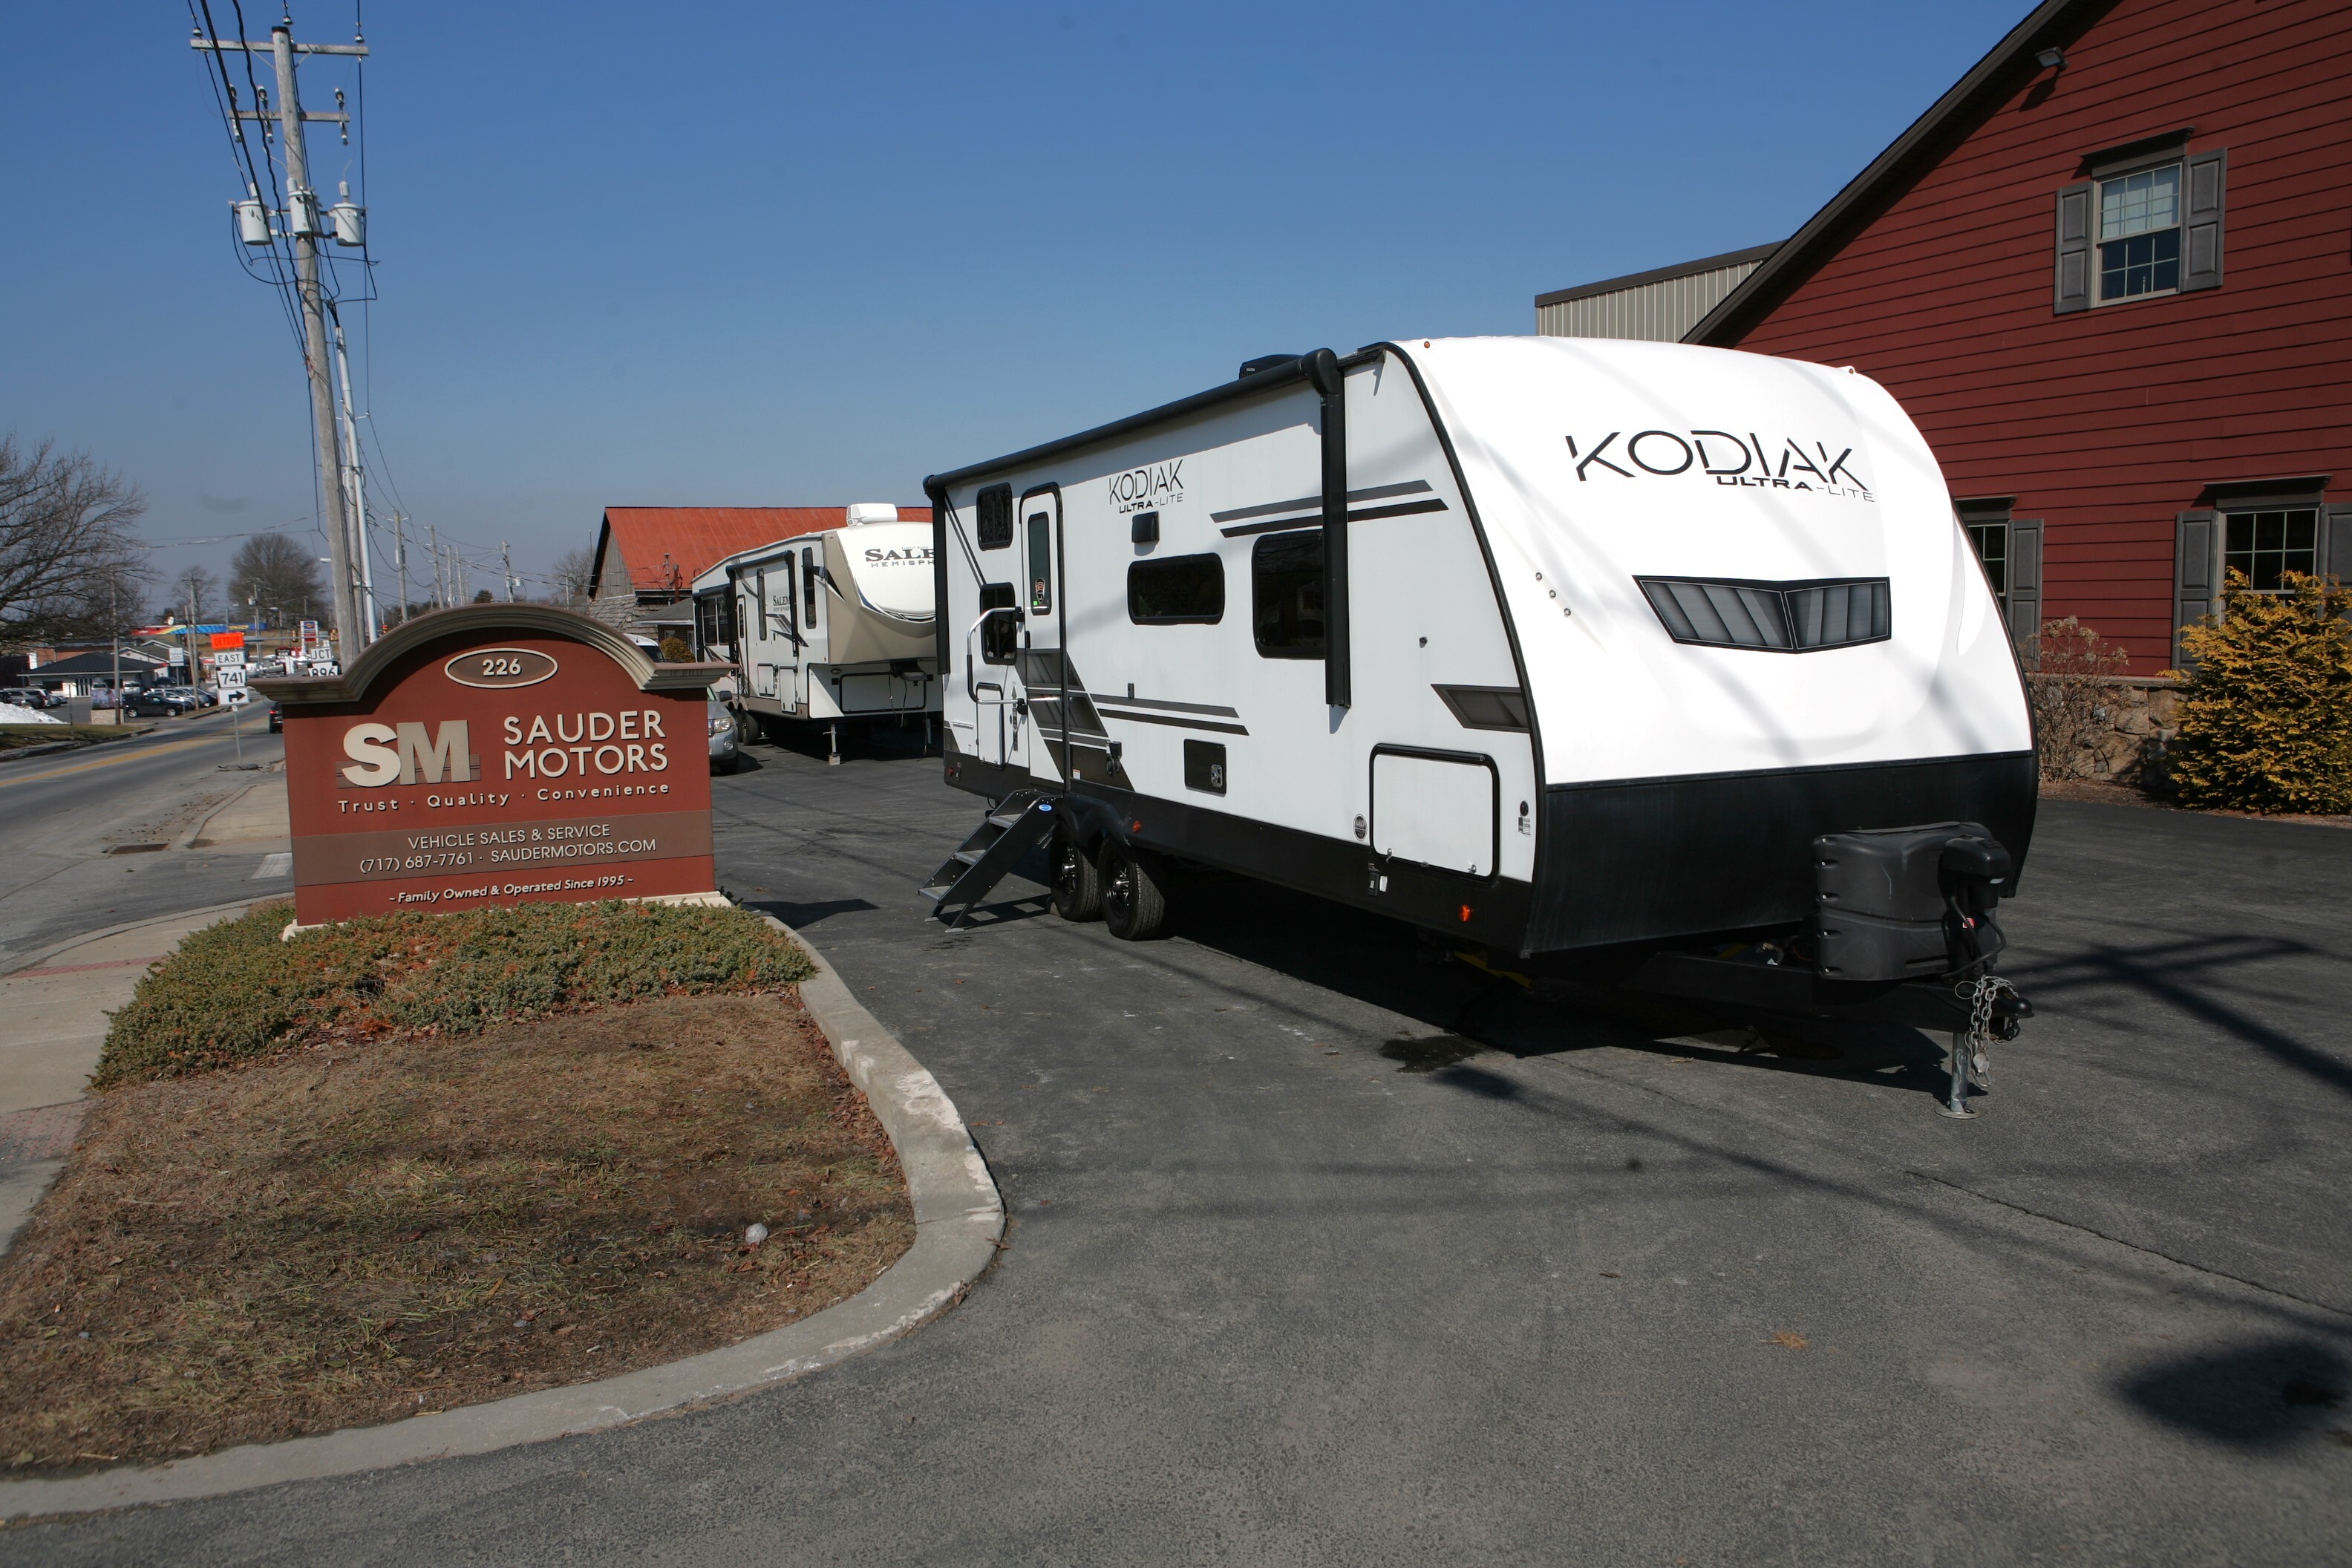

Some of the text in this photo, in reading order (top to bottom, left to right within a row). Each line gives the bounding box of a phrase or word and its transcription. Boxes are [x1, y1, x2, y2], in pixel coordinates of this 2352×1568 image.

[1565, 430, 1870, 491] KODIAK
[1108, 459, 1183, 505] KODIAK
[1716, 476, 1875, 503] ULTRA-LITE
[1119, 492, 1183, 514] ULTRA-LITE
[214, 635, 241, 646] DETOUR
[218, 653, 240, 664] EAST
[313, 649, 330, 660] JCT
[483, 659, 521, 676] 226
[220, 672, 244, 685] 741
[312, 667, 336, 676] 896
[503, 710, 666, 745] SAUDER
[342, 719, 471, 787] SM
[504, 743, 668, 780] MOTORS
[338, 784, 669, 813] Trust Quality Convenience
[408, 823, 610, 849] VEHICLE SALES & SERVICE
[360, 839, 656, 874] (717) 687-7761 SAUDERMOTORS.COM
[398, 875, 625, 904] Family Owned & Operated Since 1995
